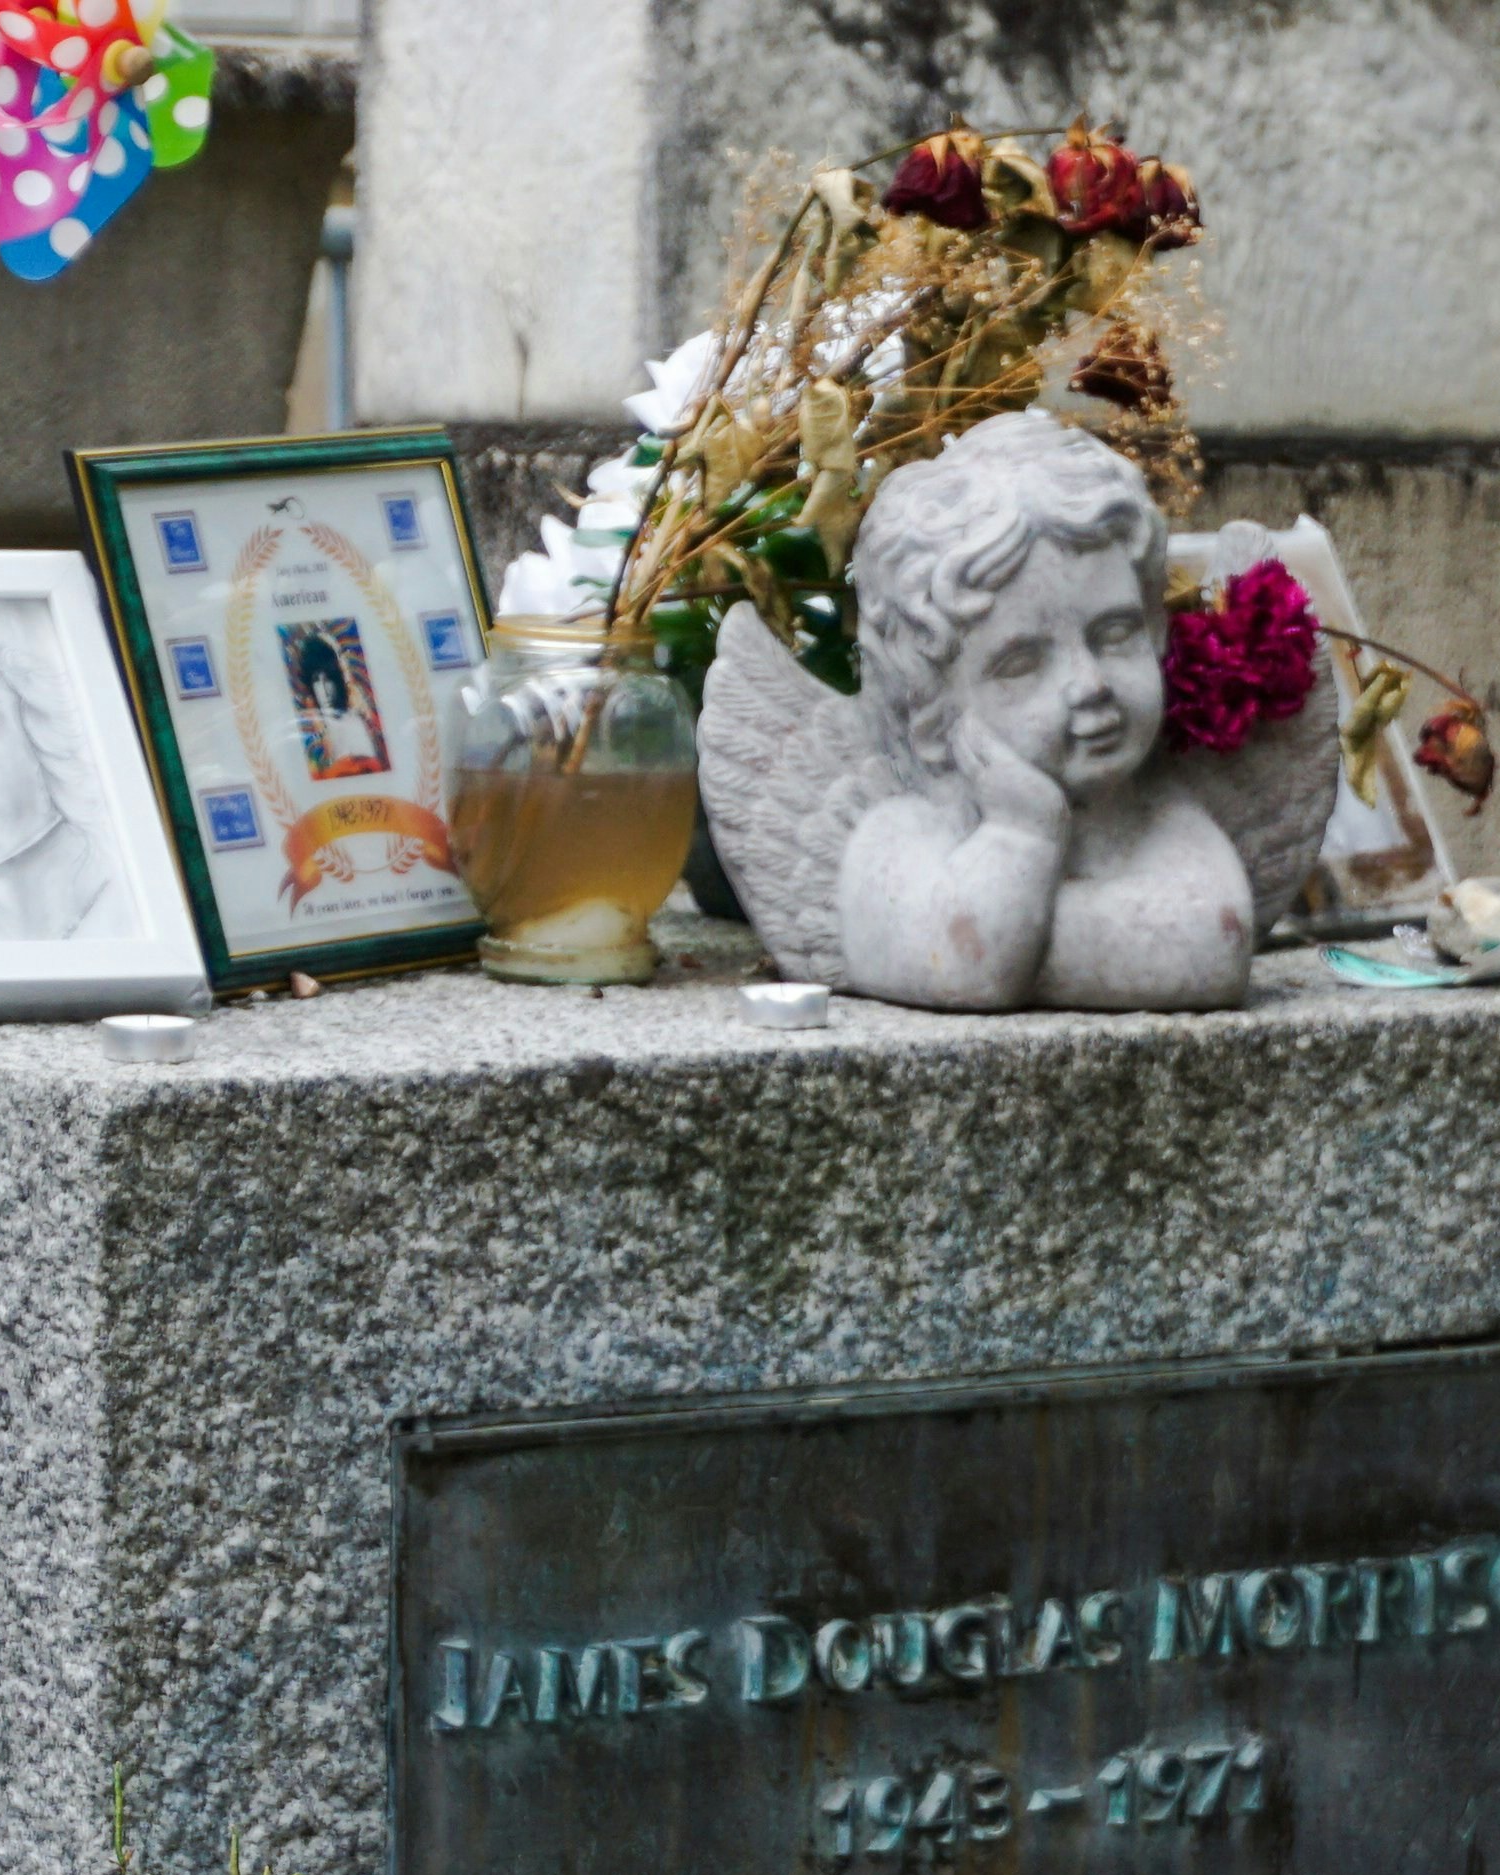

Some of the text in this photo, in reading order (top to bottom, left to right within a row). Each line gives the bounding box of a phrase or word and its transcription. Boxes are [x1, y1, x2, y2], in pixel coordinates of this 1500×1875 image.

[432, 1626, 715, 1731] JAMES
[737, 1596, 1130, 1704] DOUGLAS
[819, 1760, 1014, 1860] 1943
[1096, 1732, 1265, 1826] 1971
